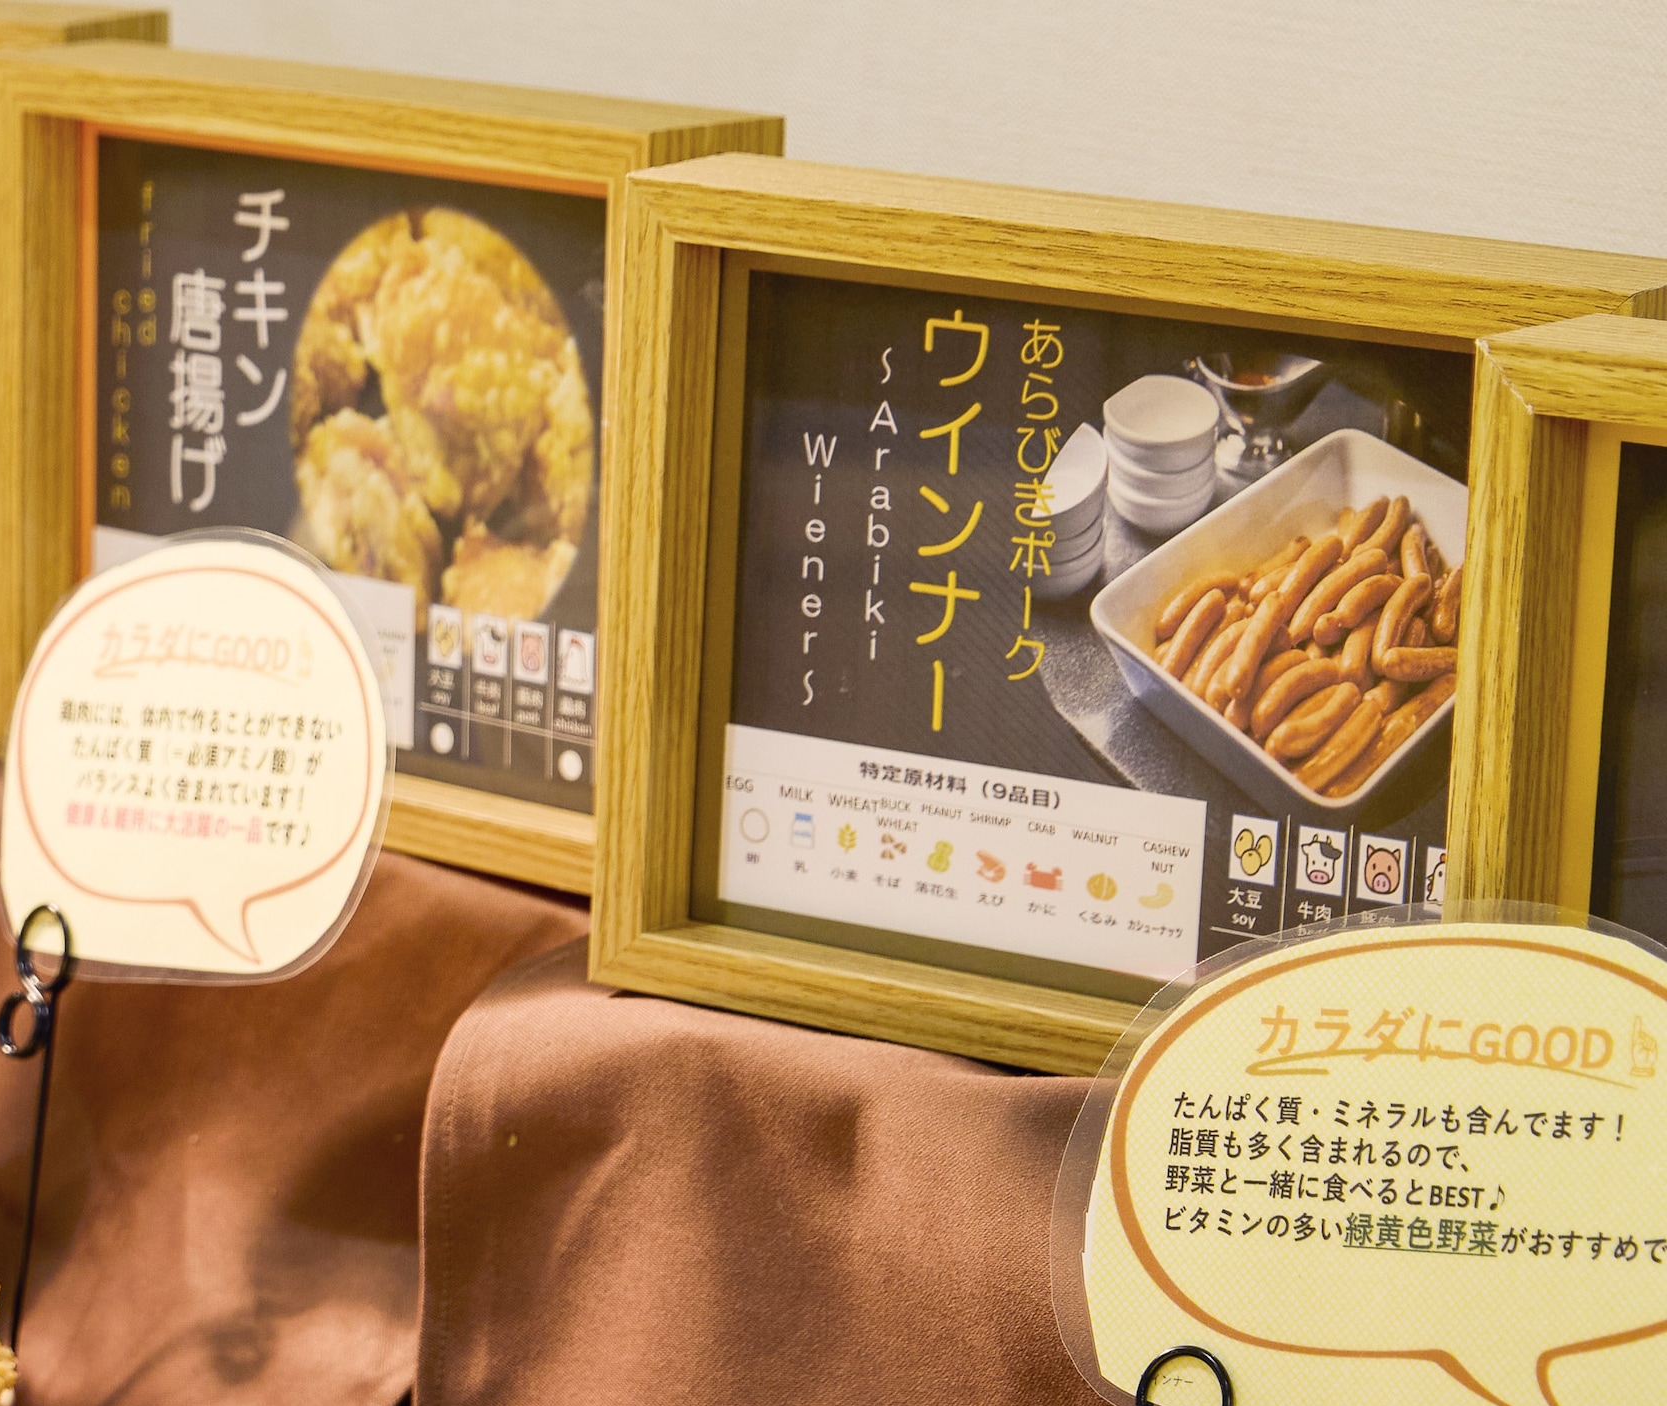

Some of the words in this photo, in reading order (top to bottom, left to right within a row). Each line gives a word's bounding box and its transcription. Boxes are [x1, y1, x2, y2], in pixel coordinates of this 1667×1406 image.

[232, 188, 291, 427] チキン
[168, 268, 228, 512] 唐揚げ
[1006, 317, 1065, 681] あらびきポーク
[909, 309, 990, 732] ウインナー
[726, 774, 755, 793] EGG
[779, 785, 815, 803] MILK
[828, 793, 879, 813] WHEAT
[880, 798, 912, 812] BUCK
[921, 803, 963, 820] PEANUT
[877, 817, 920, 833] WHEAT
[969, 812, 1012, 828] SHRIMP
[1027, 821, 1057, 836] CRAB
[1072, 829, 1119, 846] WALNUT
[1143, 840, 1191, 858] CASHEW
[1151, 861, 1175, 874] NUT
[1227, 886, 1264, 910] 大豆
[1078, 910, 1119, 926] くるみ
[1231, 913, 1257, 930] soy
[1297, 901, 1333, 924] 牛肉
[1127, 920, 1184, 938] カシューナッツ
[1257, 1003, 1615, 1070] カラダにGOOD
[1173, 1090, 1625, 1142] たんぱく質・ミネラルも含んでます！
[1167, 1126, 1470, 1173] 脂質も多く含まれるので、
[1143, 1373, 1194, 1387] インナー
